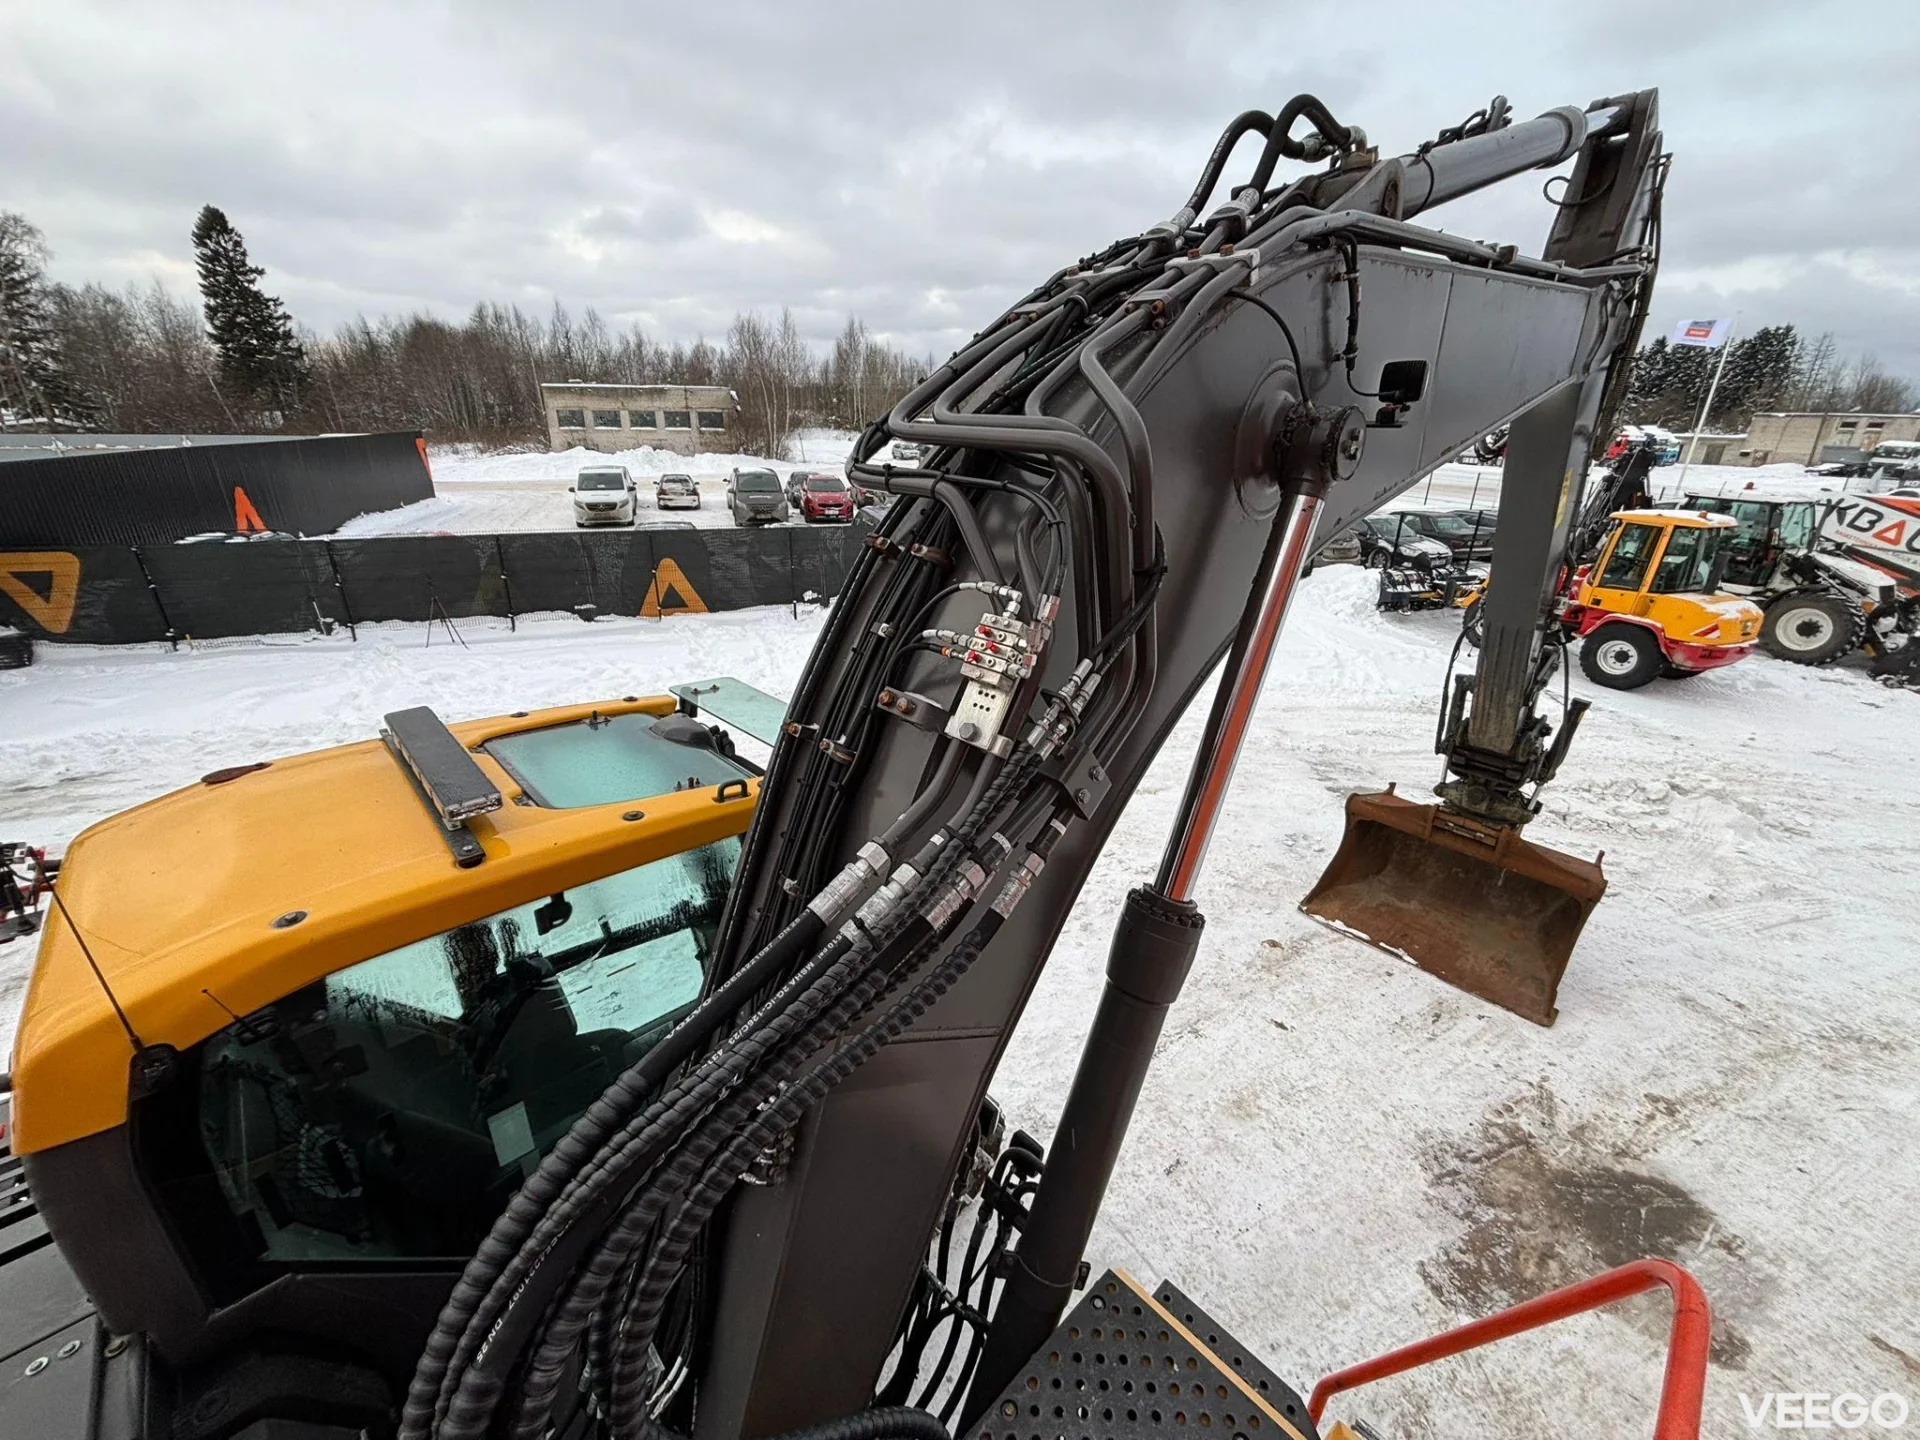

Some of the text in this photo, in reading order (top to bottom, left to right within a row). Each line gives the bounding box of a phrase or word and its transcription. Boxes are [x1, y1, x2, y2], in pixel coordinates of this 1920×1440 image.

[827, 931, 845, 949] 510
[788, 960, 815, 986] MSHA
[663, 997, 712, 1041] VOLVO
[487, 1317, 504, 1343] DN
[476, 1341, 489, 1363] 25
